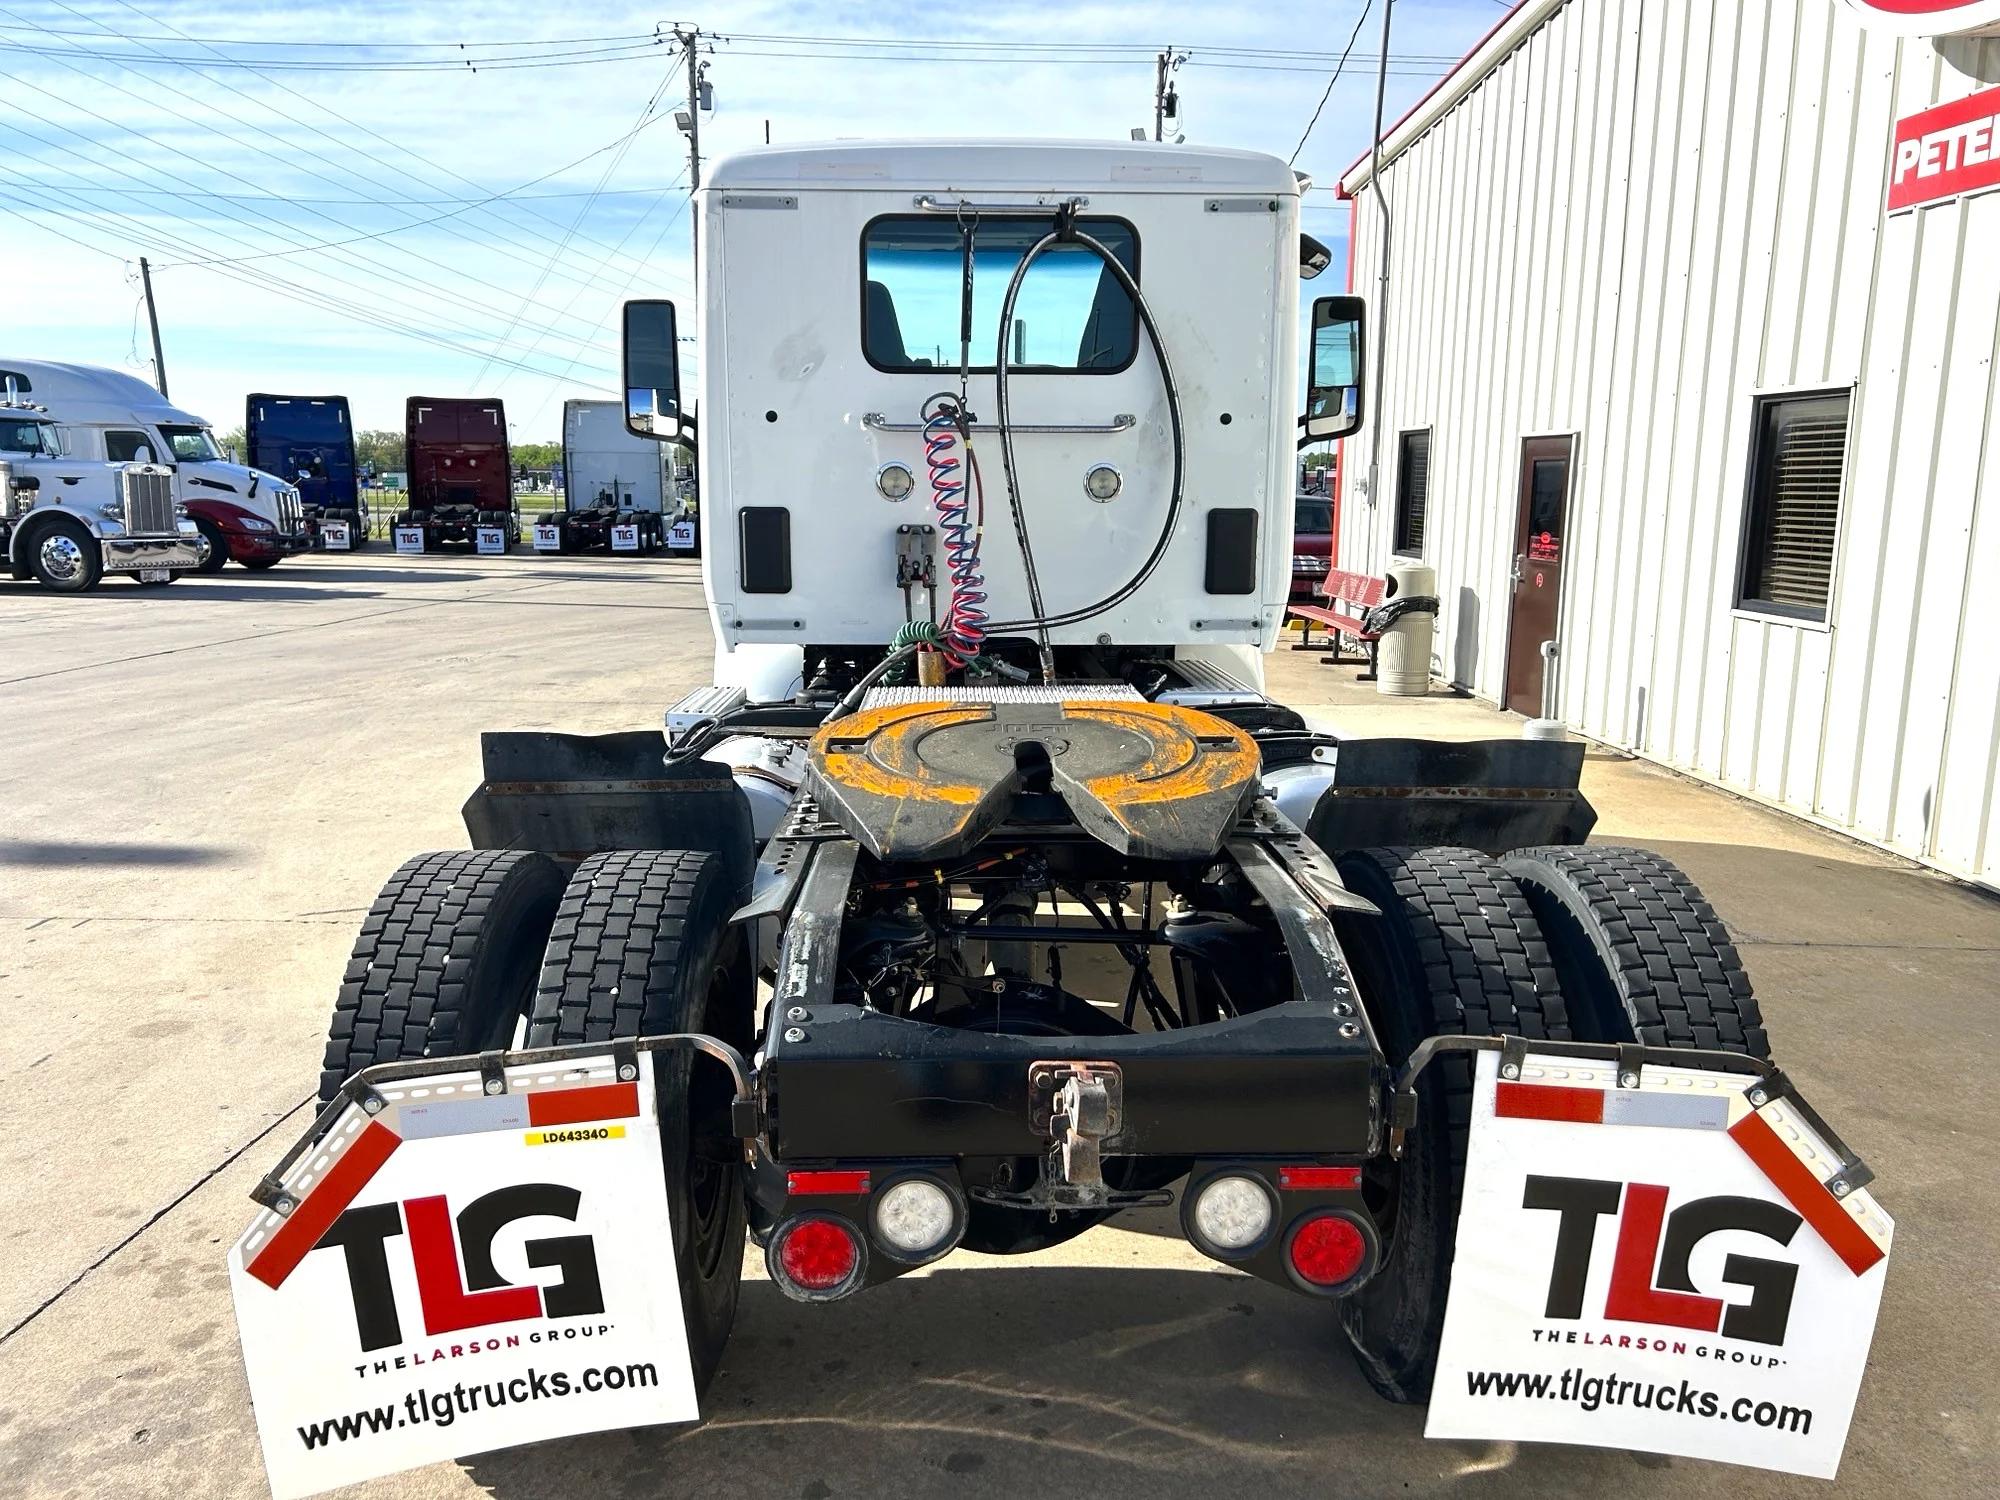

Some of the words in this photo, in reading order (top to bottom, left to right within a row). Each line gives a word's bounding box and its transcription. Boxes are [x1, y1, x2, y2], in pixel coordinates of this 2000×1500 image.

[400, 533, 418, 544] TLG
[481, 533, 499, 544] TLG
[538, 530, 555, 540] TLG
[616, 530, 633, 540] TLG
[311, 1182, 605, 1353] TLG
[1522, 1174, 1804, 1347] TLG
[296, 1359, 659, 1451] www.tlgtrucks.com
[1466, 1367, 1813, 1436] www.tlgtrucks.com
